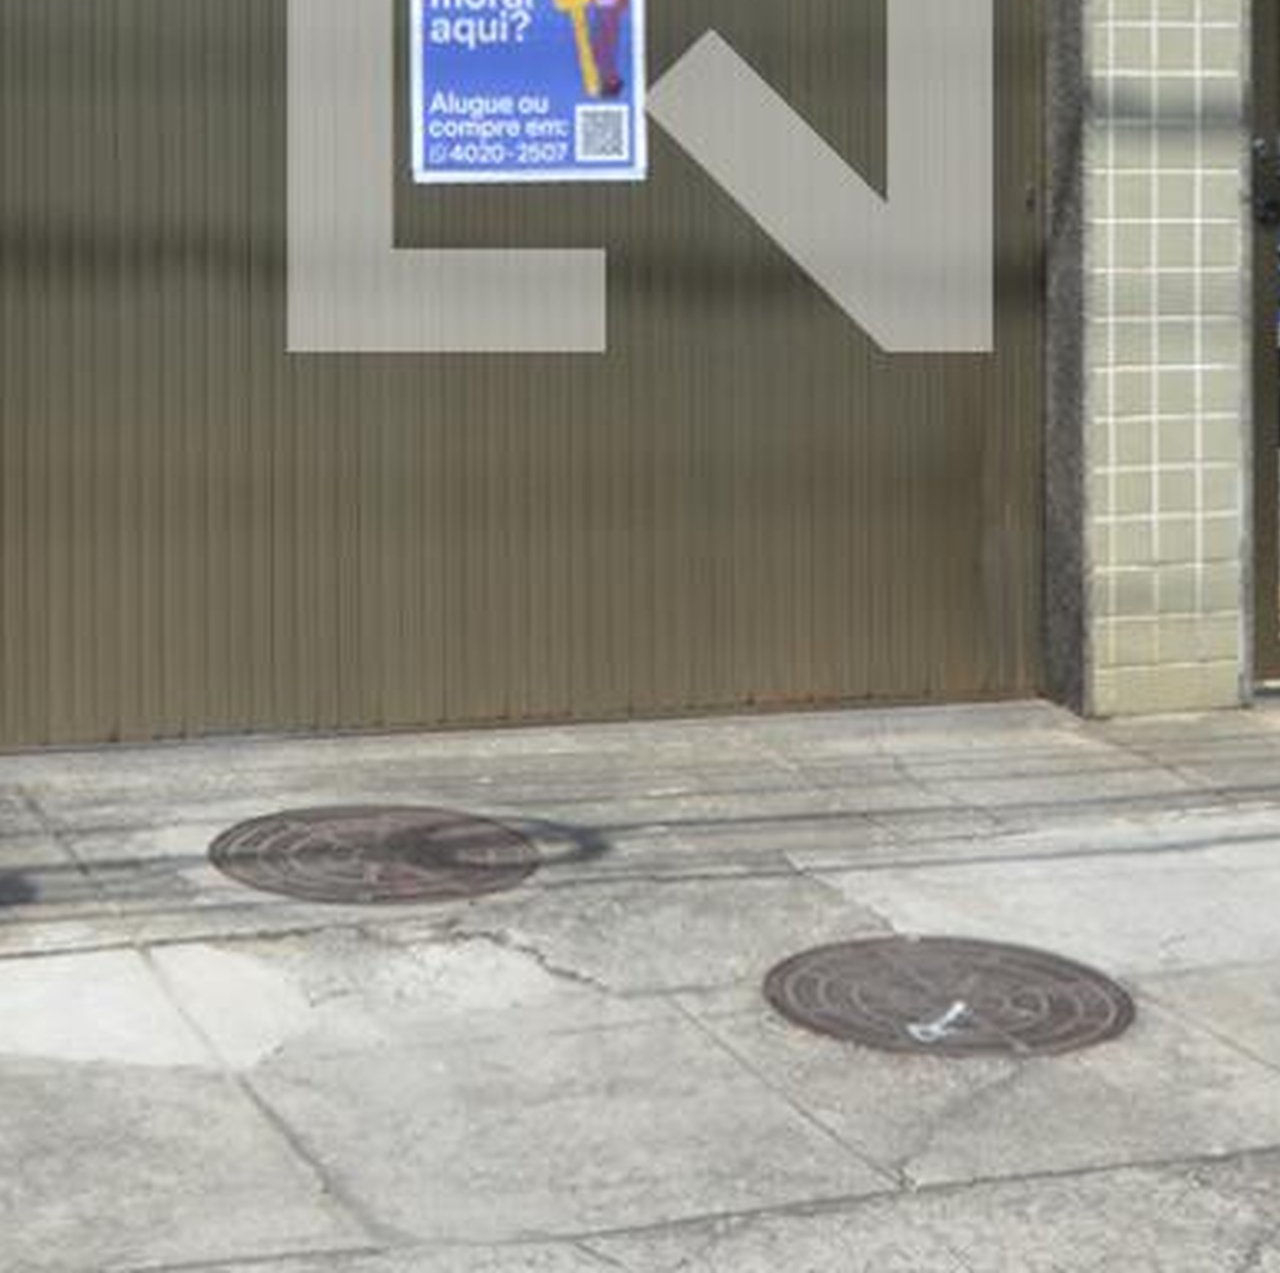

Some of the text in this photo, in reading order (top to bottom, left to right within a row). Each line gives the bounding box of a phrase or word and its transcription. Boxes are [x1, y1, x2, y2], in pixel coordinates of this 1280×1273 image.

[430, 10, 532, 50] aqui?
[429, 90, 514, 119] Alugue
[518, 96, 550, 115] ou
[429, 120, 521, 143] compre
